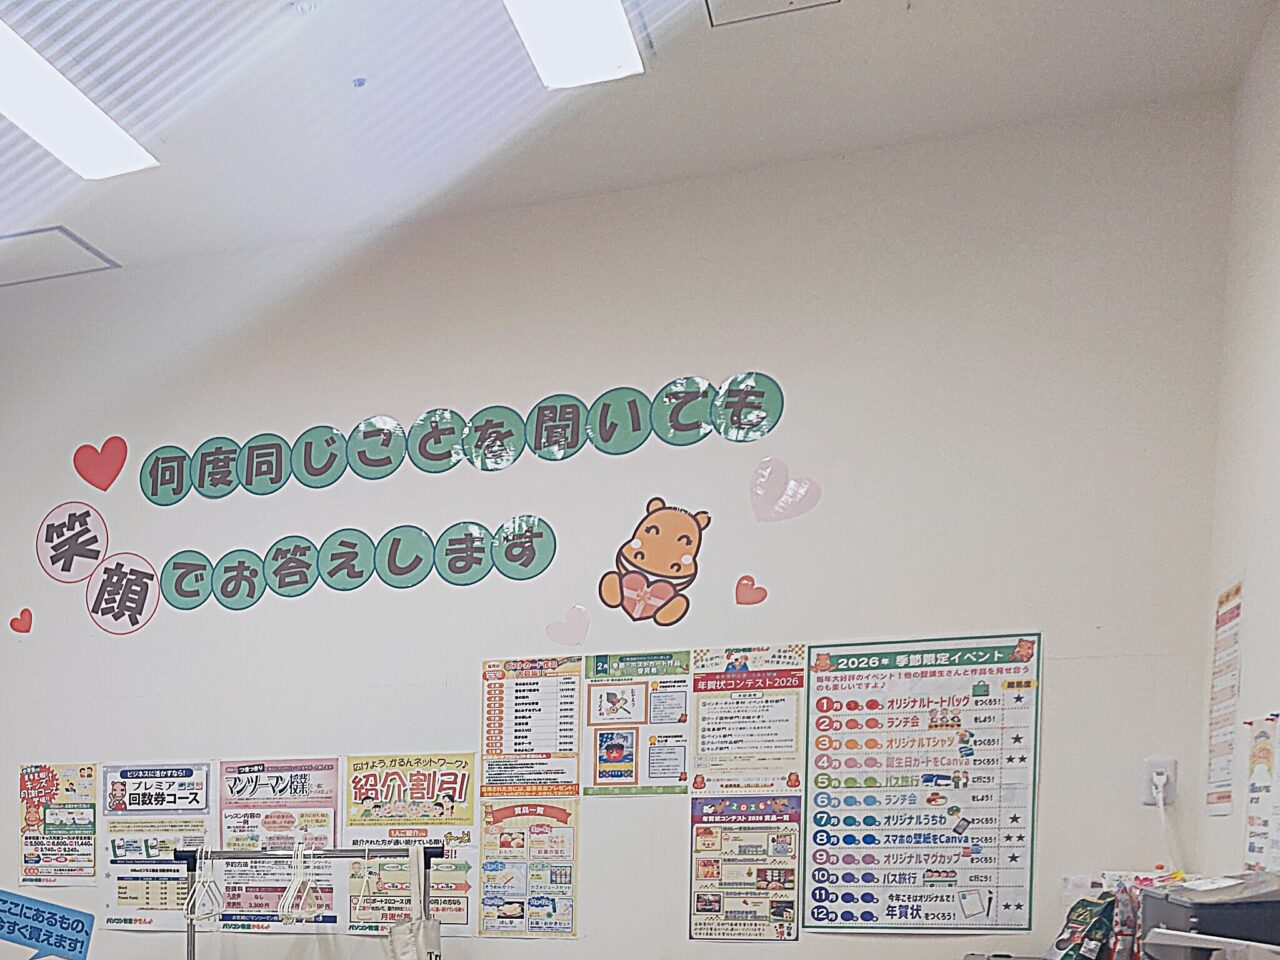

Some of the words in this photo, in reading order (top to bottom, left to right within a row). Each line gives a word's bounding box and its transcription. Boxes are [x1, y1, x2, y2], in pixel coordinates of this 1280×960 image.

[147, 384, 770, 498] 何度同じことを聞いても
[837, 656, 890, 669] 2026年
[895, 651, 1005, 668] 季節限定イベント
[697, 676, 799, 690] 年賀状コンテスト2026
[886, 695, 970, 710] オリジナルトートバッグ
[886, 716, 920, 728] ランチ会
[886, 735, 955, 749] オリジナルTシャツ
[886, 756, 970, 769] 誕生日カードをCanva
[132, 781, 176, 791] プレミア
[350, 770, 469, 803] 紹介割引
[885, 773, 920, 786] バス旅行
[127, 792, 201, 807] 回数券コース
[884, 793, 918, 806] ランチ会
[883, 813, 947, 826] オリジナルうちわ
[883, 832, 969, 845] スマホの壁紙をCanva
[883, 851, 961, 865] オリジナルマグカップ
[883, 872, 918, 885] バス旅行
[885, 904, 923, 920] 年賀状
